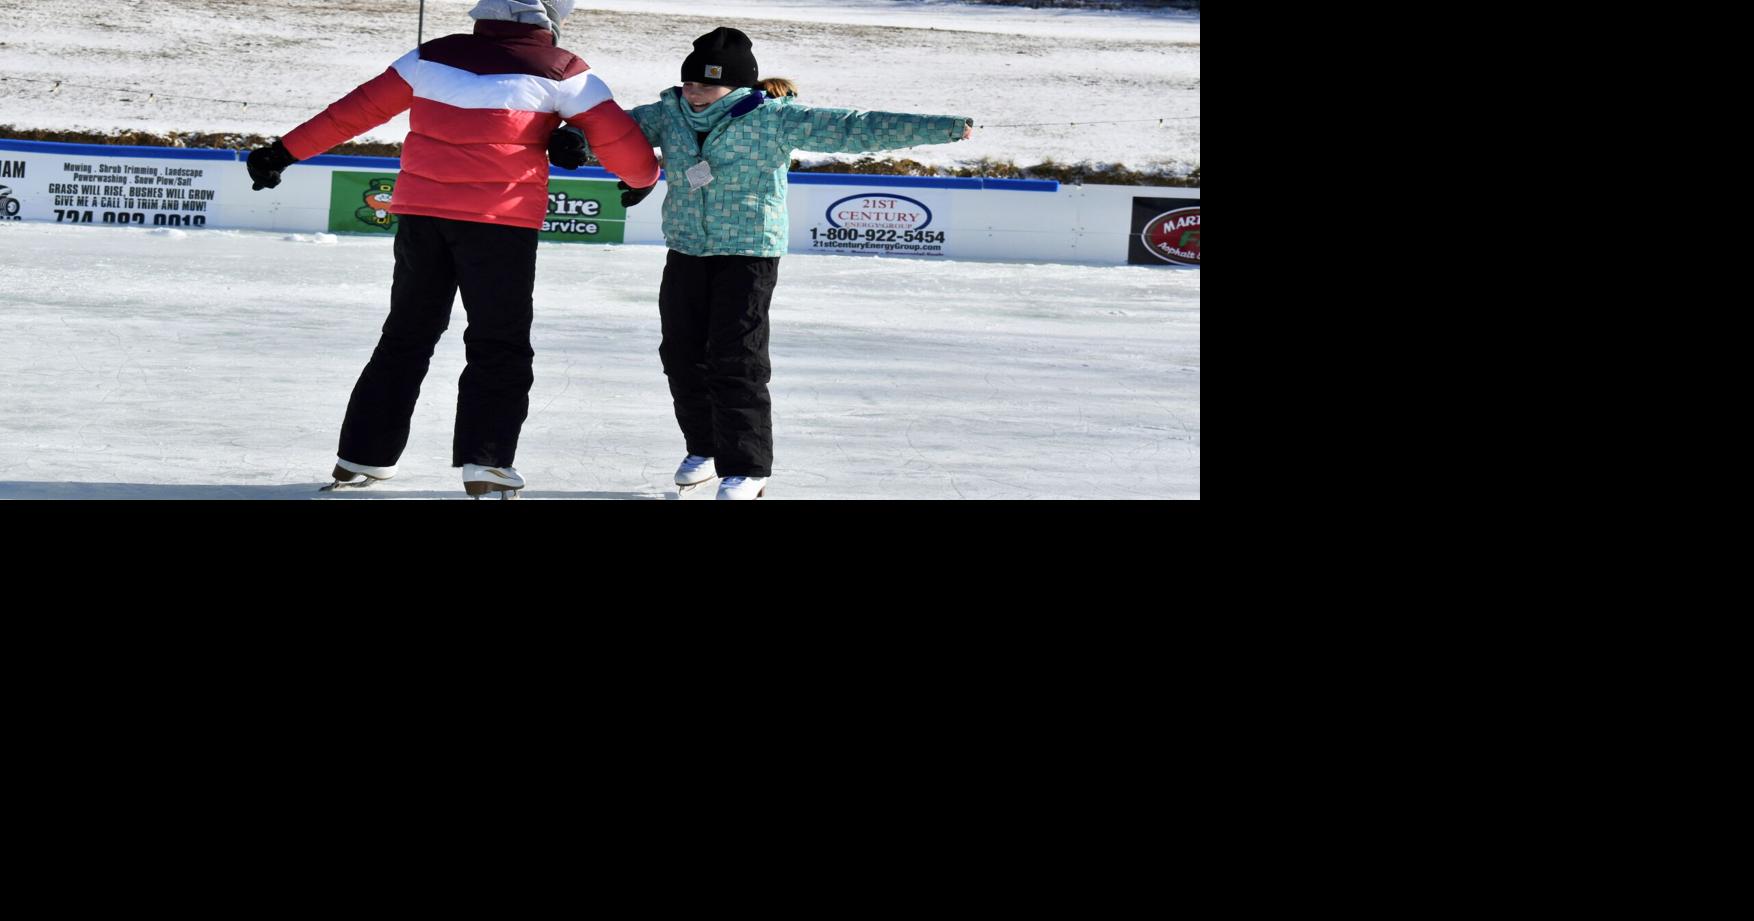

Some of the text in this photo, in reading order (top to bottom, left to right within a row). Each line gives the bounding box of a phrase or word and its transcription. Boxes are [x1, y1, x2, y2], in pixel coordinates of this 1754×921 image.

[0, 160, 26, 178] AM
[64, 163, 203, 178] Mowing Shrub Trimming Landscape
[73, 173, 192, 186] Powerwashing Snow Plow/Salt
[49, 183, 215, 200] GRASS WILL RISE, BUSHES WILL GROW
[54, 195, 207, 212] GIVE ME A CALL TO TRIM AND MOW!
[863, 199, 898, 209] 21ST
[838, 211, 920, 222] CENTURY
[542, 219, 598, 233] ervice
[810, 227, 945, 243] 1-800-922-5454
[813, 240, 942, 252] 21stCenturyEnergyGroup.com
[1157, 242, 1196, 259] Asphalt
